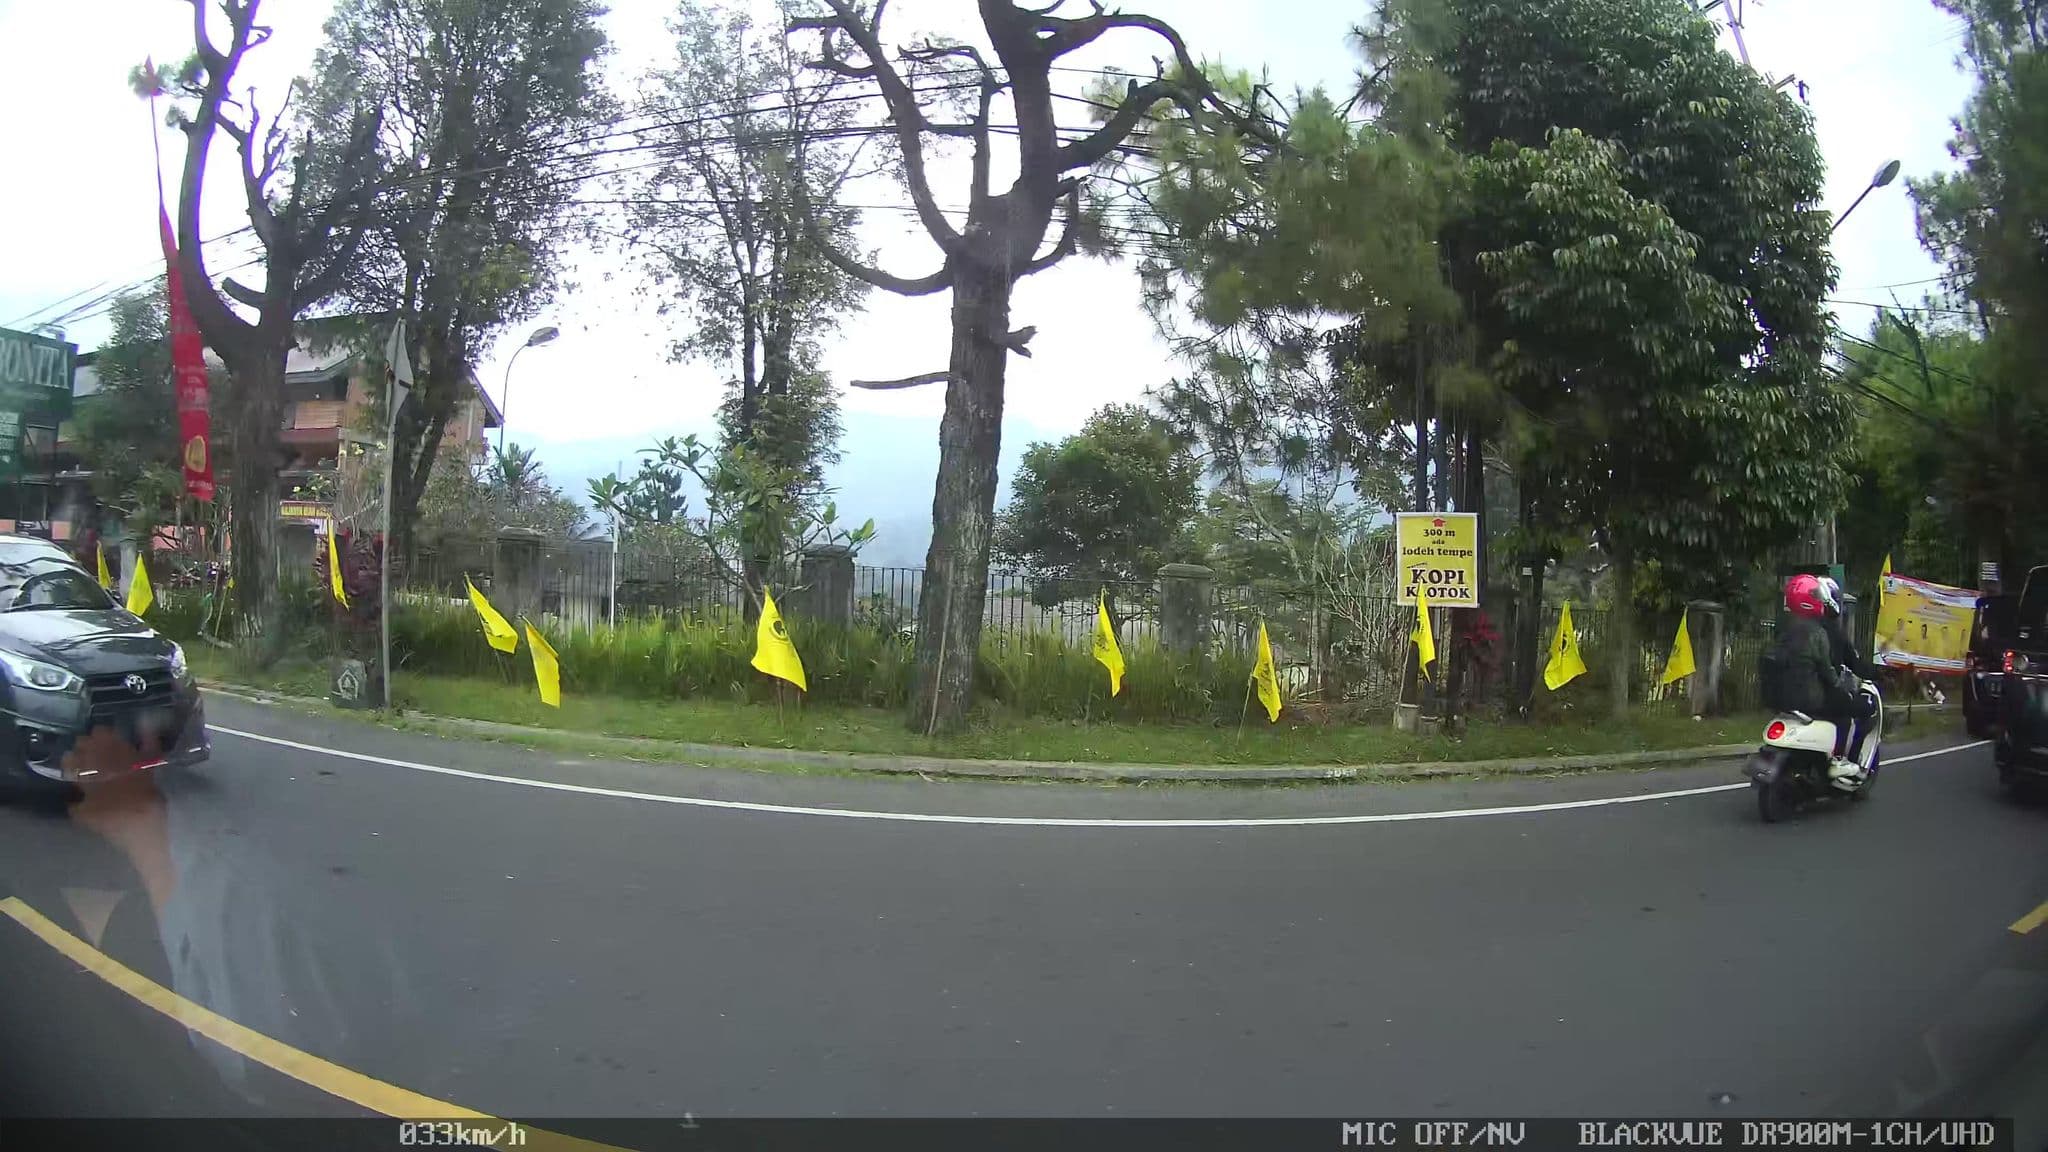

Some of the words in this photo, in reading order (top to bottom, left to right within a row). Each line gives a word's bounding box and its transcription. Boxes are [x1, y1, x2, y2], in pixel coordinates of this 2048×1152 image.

[1402, 547, 1434, 556] lodeh
[1437, 548, 1473, 558] tempe
[1412, 569, 1464, 584] KOPI
[1406, 587, 1470, 598] KOTOK
